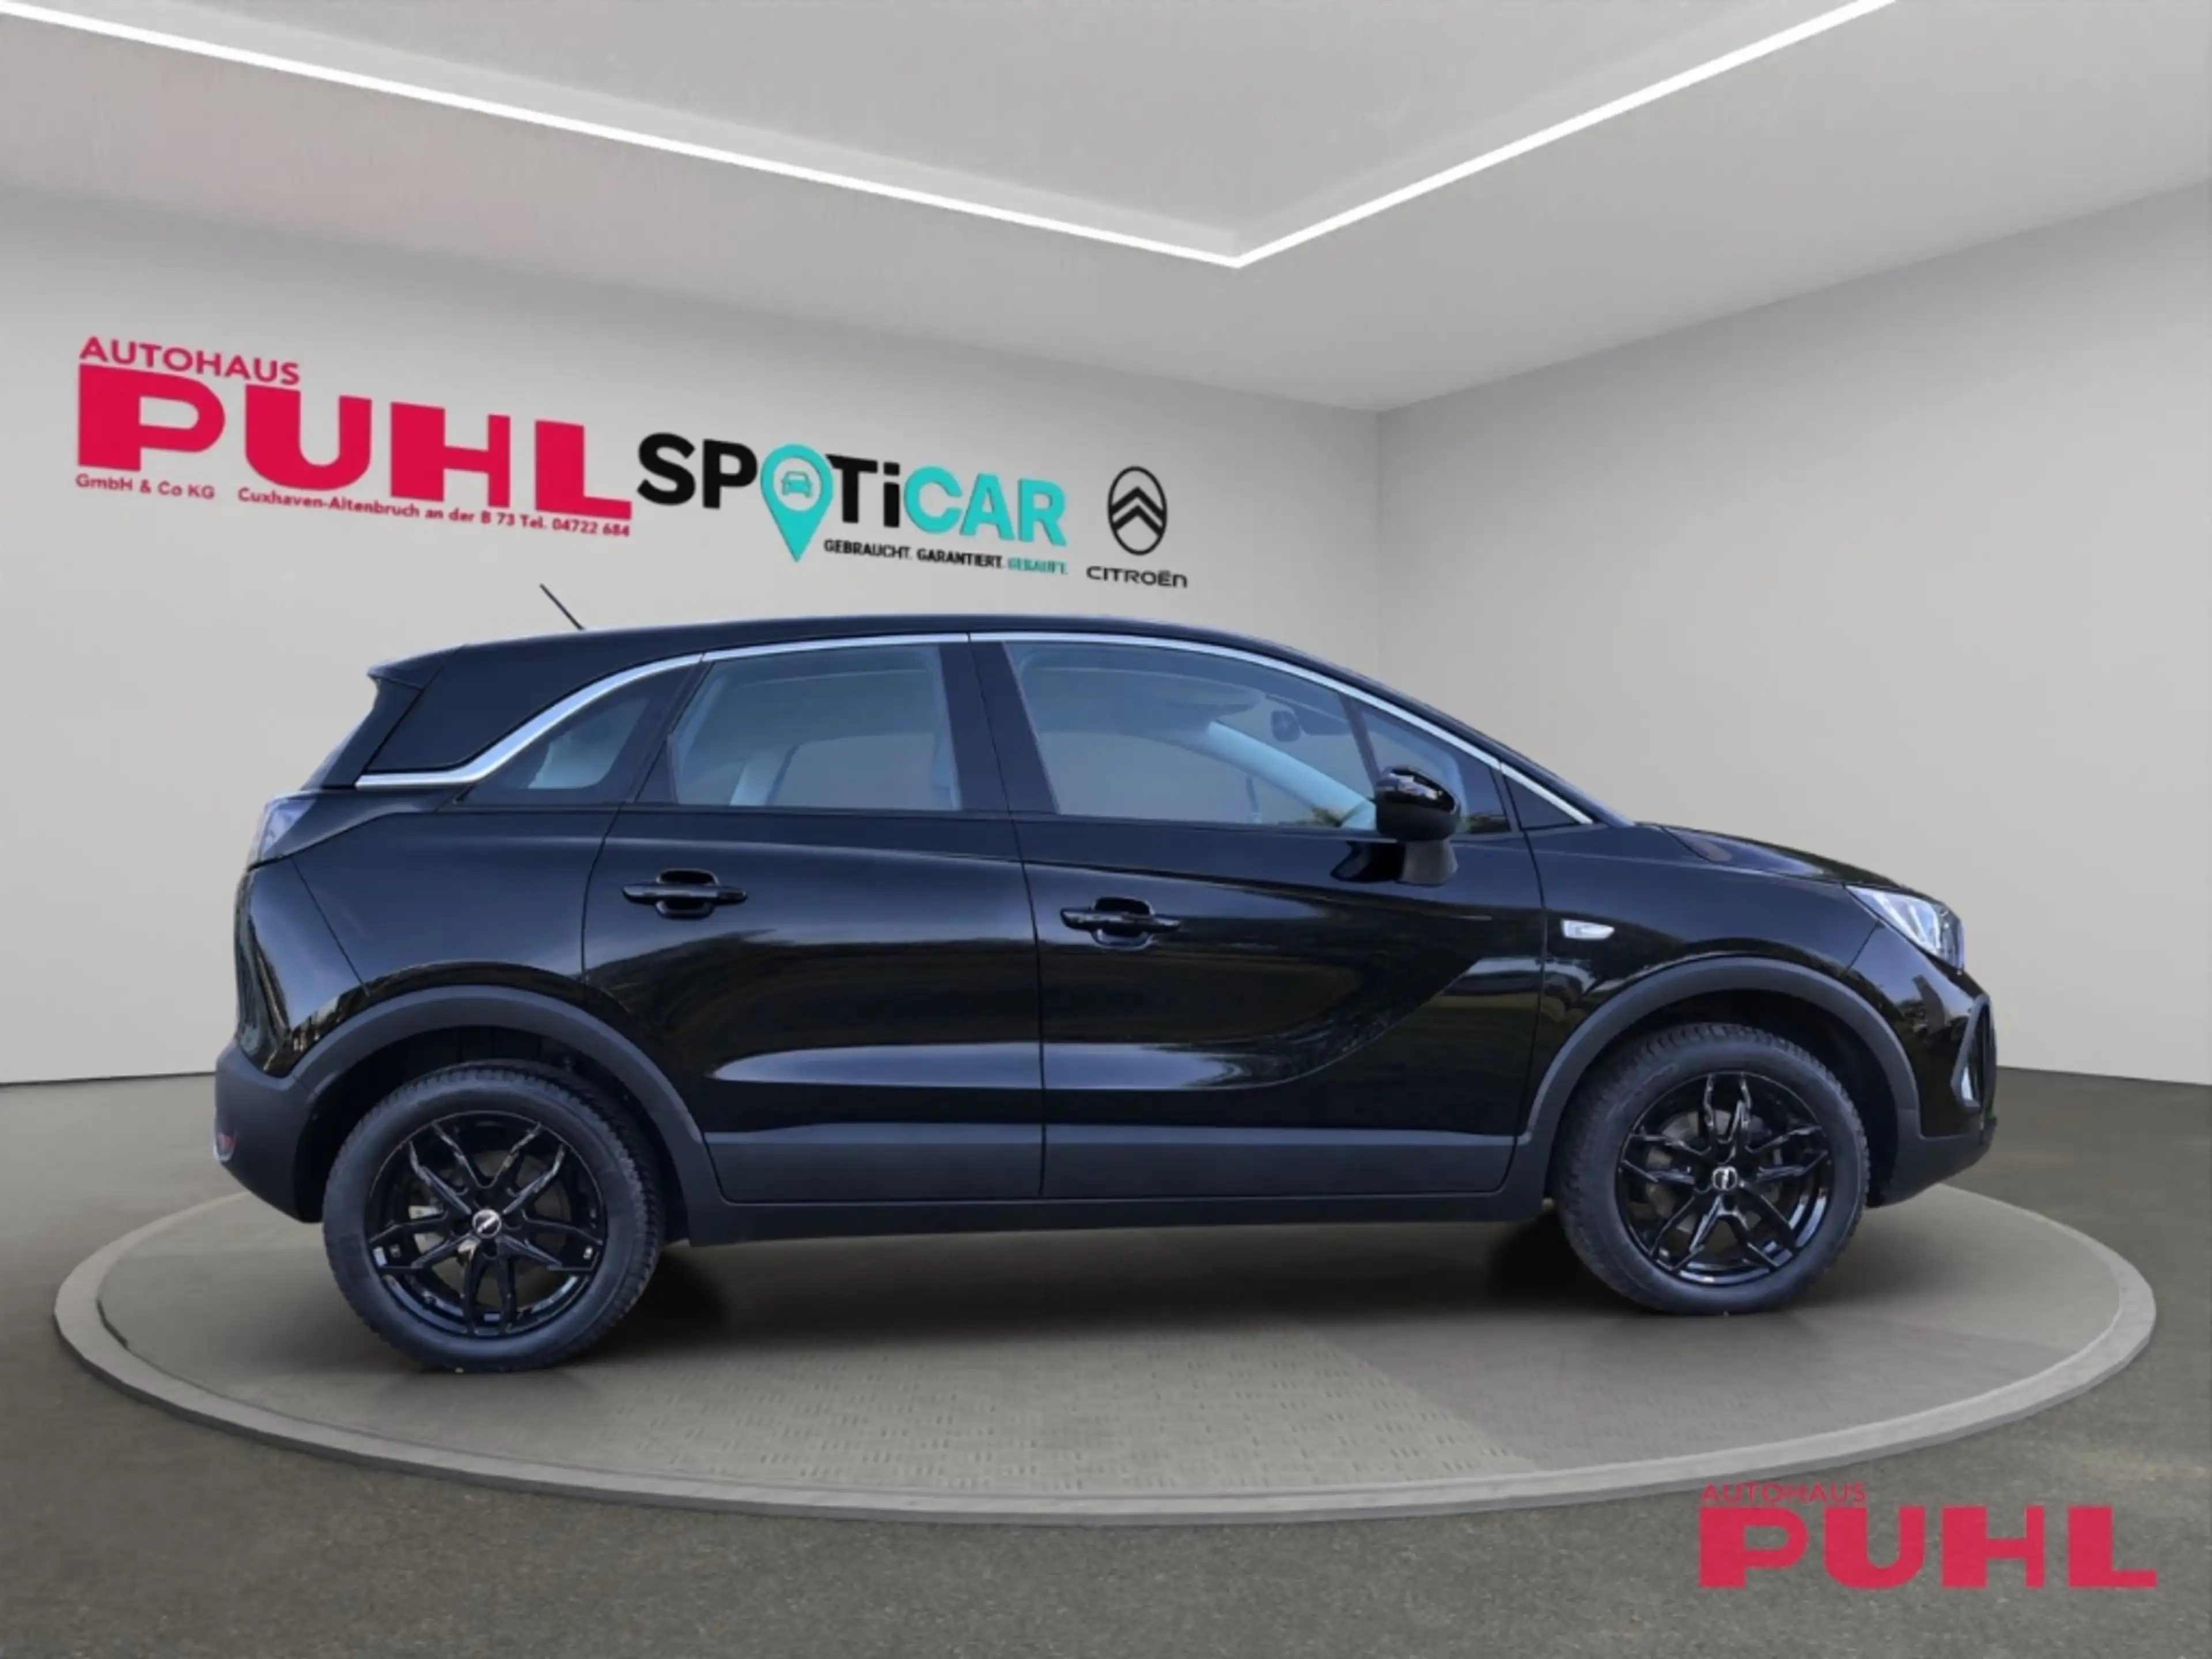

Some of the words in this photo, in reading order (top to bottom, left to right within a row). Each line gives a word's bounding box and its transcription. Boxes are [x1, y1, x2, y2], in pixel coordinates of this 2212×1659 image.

[79, 336, 300, 386] AUTOHAUS
[78, 363, 632, 520] PUHL
[75, 473, 133, 491] GmbH
[140, 479, 151, 494] &
[157, 480, 183, 497] Co
[188, 484, 215, 499] KG
[237, 487, 420, 518] Cuxhaven-Altenbruch
[425, 509, 443, 519] an
[448, 508, 474, 522] der
[481, 511, 491, 524] B
[497, 512, 515, 526] 73
[520, 514, 547, 529] Tel.
[551, 518, 598, 535] 04722
[603, 523, 630, 537] 684
